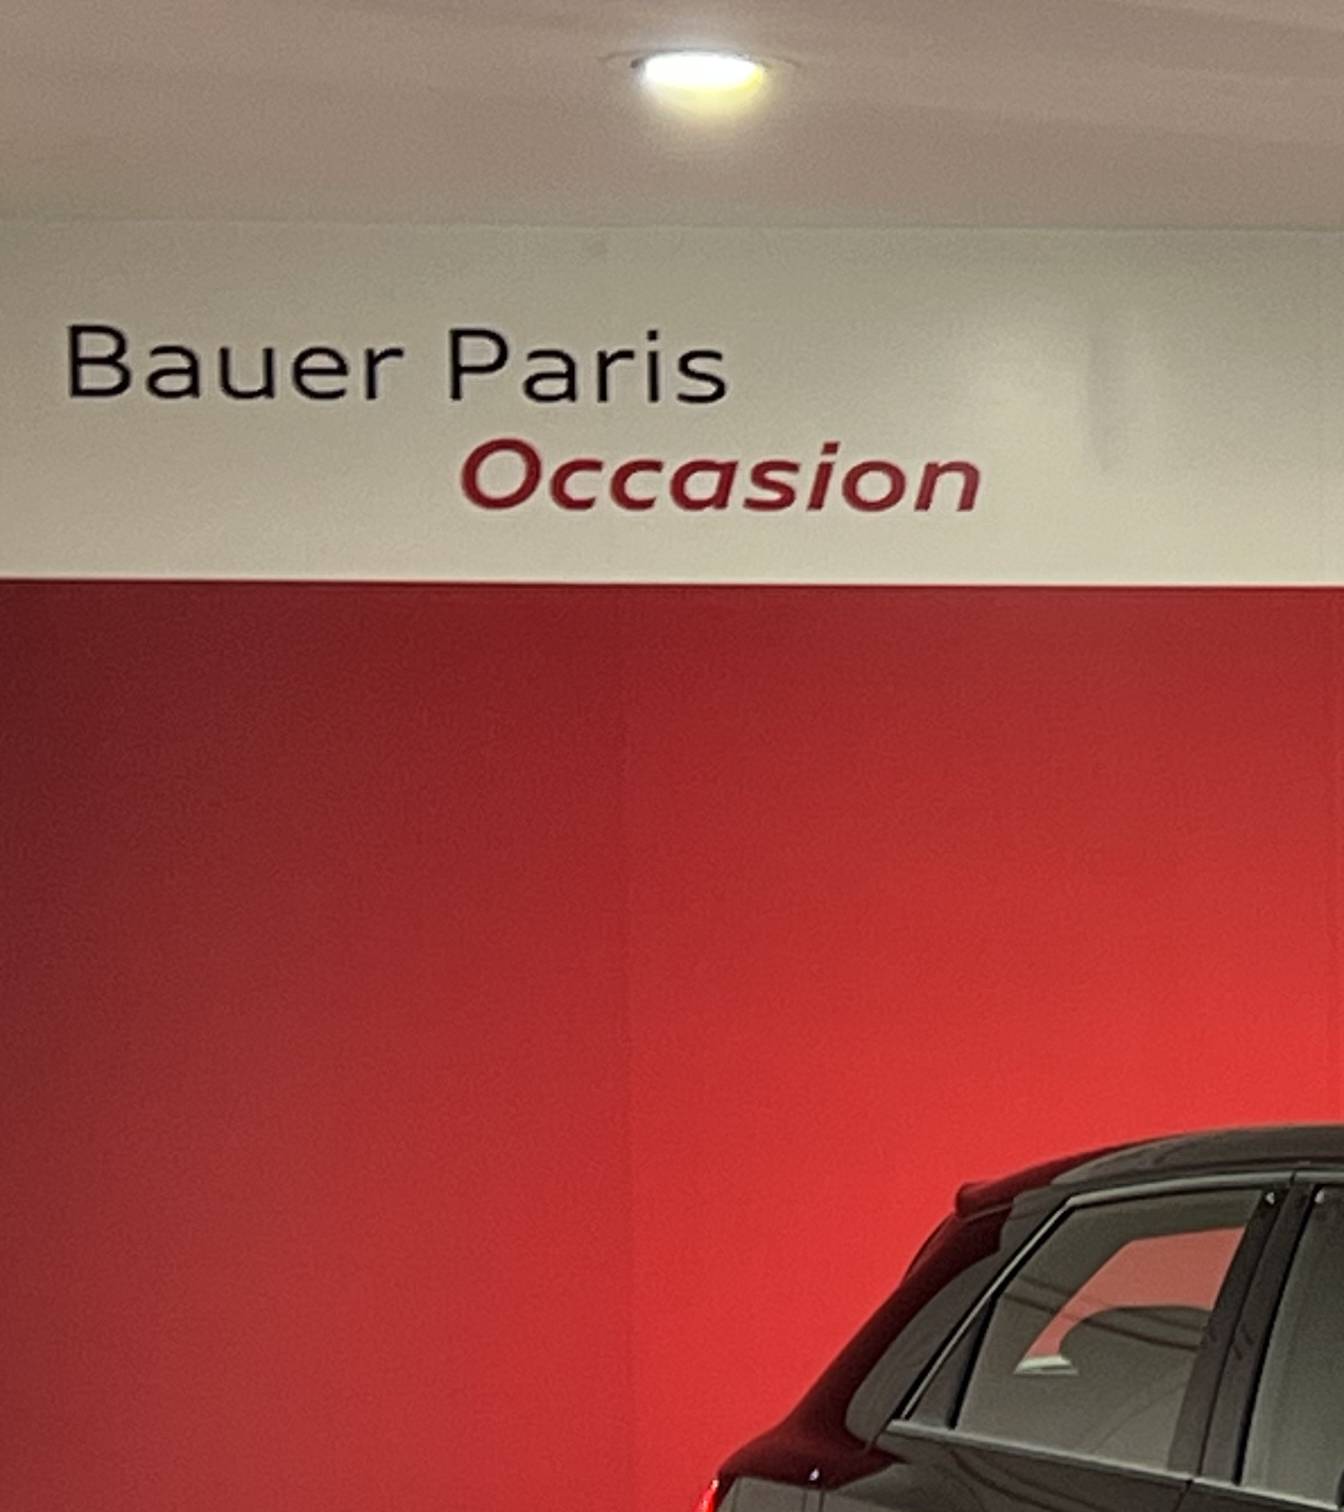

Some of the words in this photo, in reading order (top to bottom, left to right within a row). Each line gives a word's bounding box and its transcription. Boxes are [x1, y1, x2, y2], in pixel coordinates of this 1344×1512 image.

[67, 324, 405, 401] Bauer
[448, 328, 727, 404] Paris
[460, 438, 981, 512] Occasion
